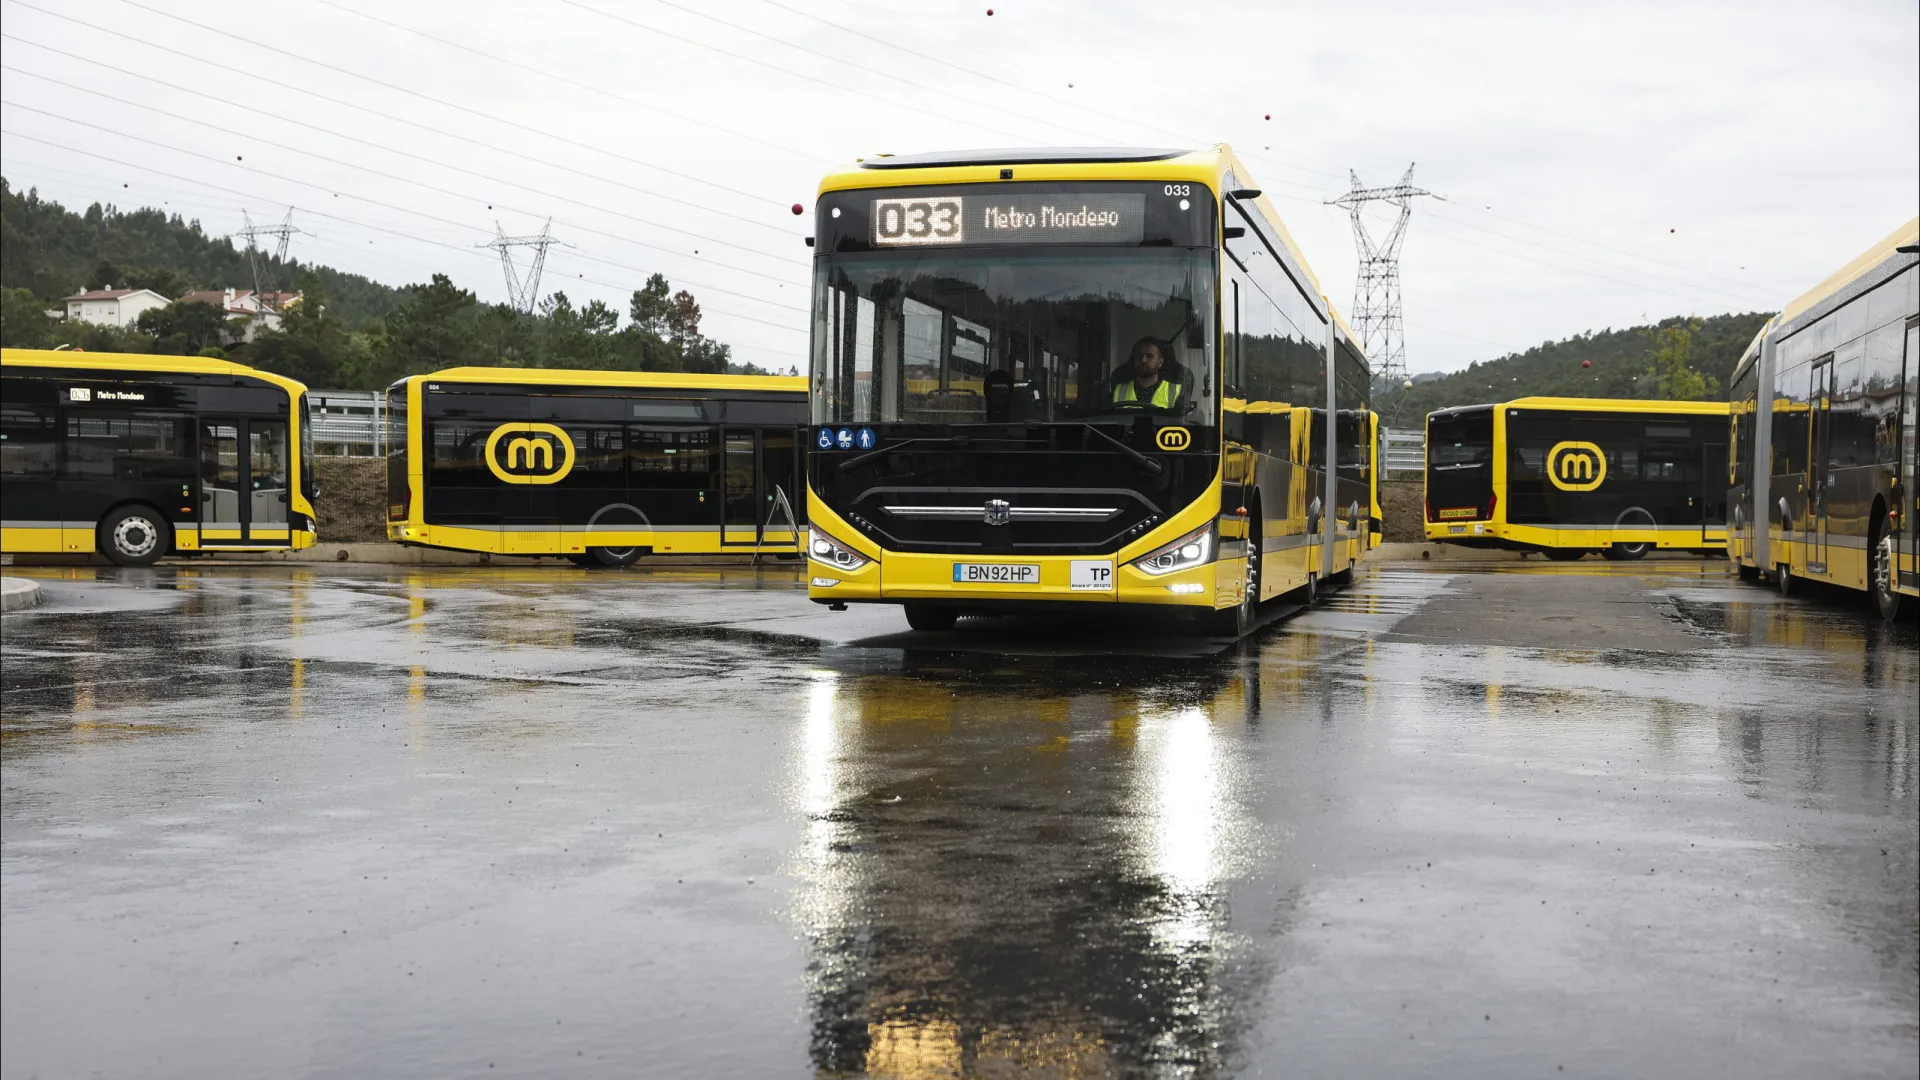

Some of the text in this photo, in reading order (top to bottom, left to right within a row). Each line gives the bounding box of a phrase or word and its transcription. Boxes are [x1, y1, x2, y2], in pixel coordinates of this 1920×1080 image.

[1164, 185, 1191, 196] 033
[877, 202, 1119, 238] 033 Metro Mondego
[97, 390, 116, 399] Metro
[1090, 568, 1110, 580] TP
